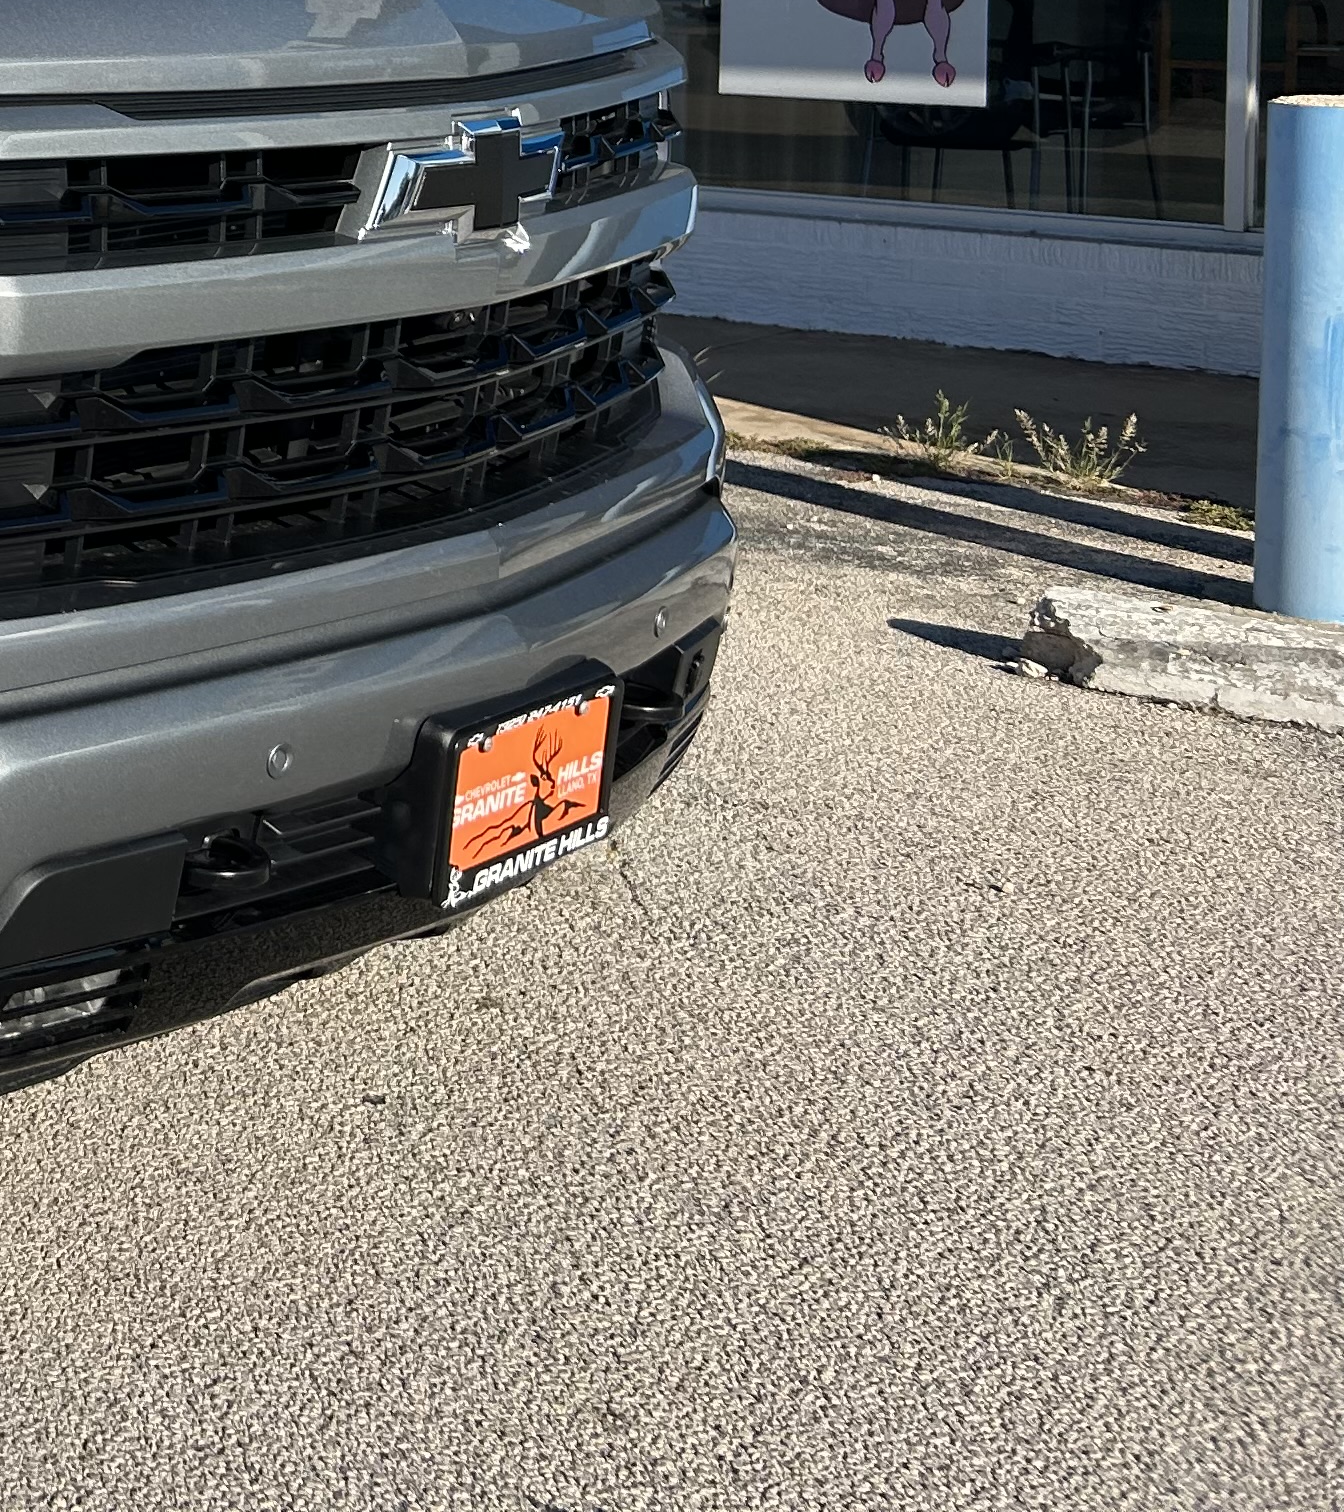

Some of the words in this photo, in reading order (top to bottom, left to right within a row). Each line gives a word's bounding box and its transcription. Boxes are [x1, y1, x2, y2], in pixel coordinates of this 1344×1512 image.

[452, 782, 528, 829] GRANITE
[557, 750, 604, 785] HILLS
[464, 774, 512, 802] CHEVROLET
[586, 771, 598, 785] TX
[472, 838, 559, 893] GRANITE
[557, 815, 610, 856] HILLS
